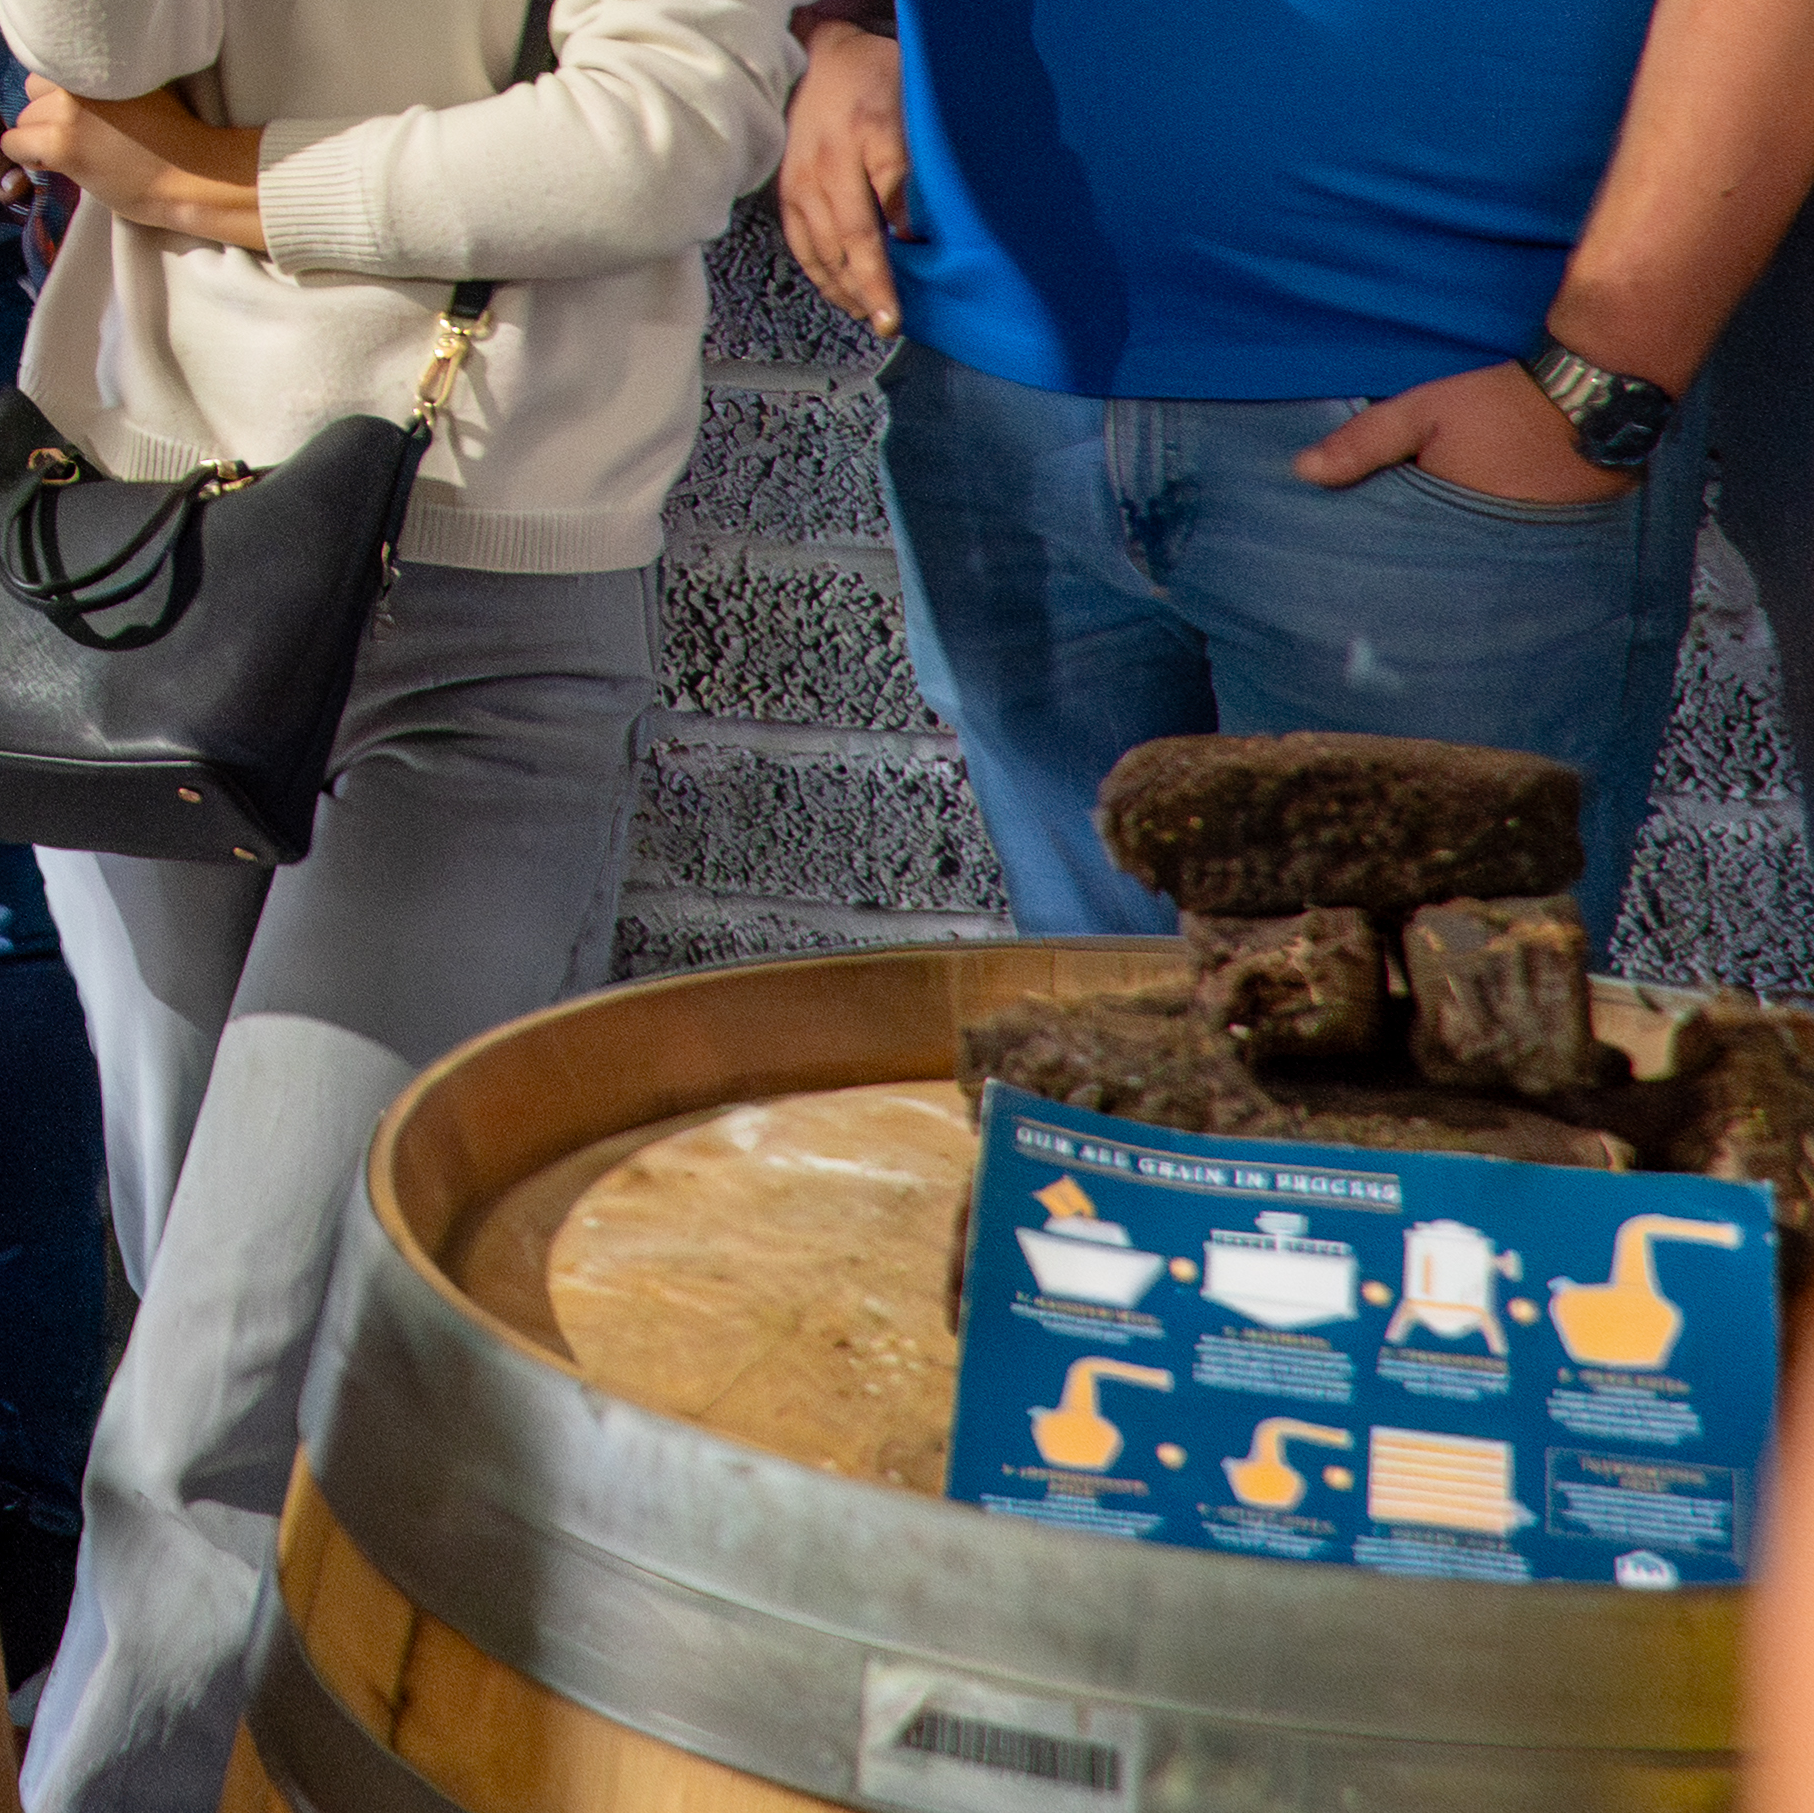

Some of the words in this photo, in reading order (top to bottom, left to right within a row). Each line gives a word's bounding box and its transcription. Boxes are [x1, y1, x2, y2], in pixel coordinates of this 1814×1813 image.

[1137, 1157, 1228, 1186] GRAIN
[1234, 1168, 1269, 1191] IN
[1275, 1172, 1402, 1204] PROCESS
